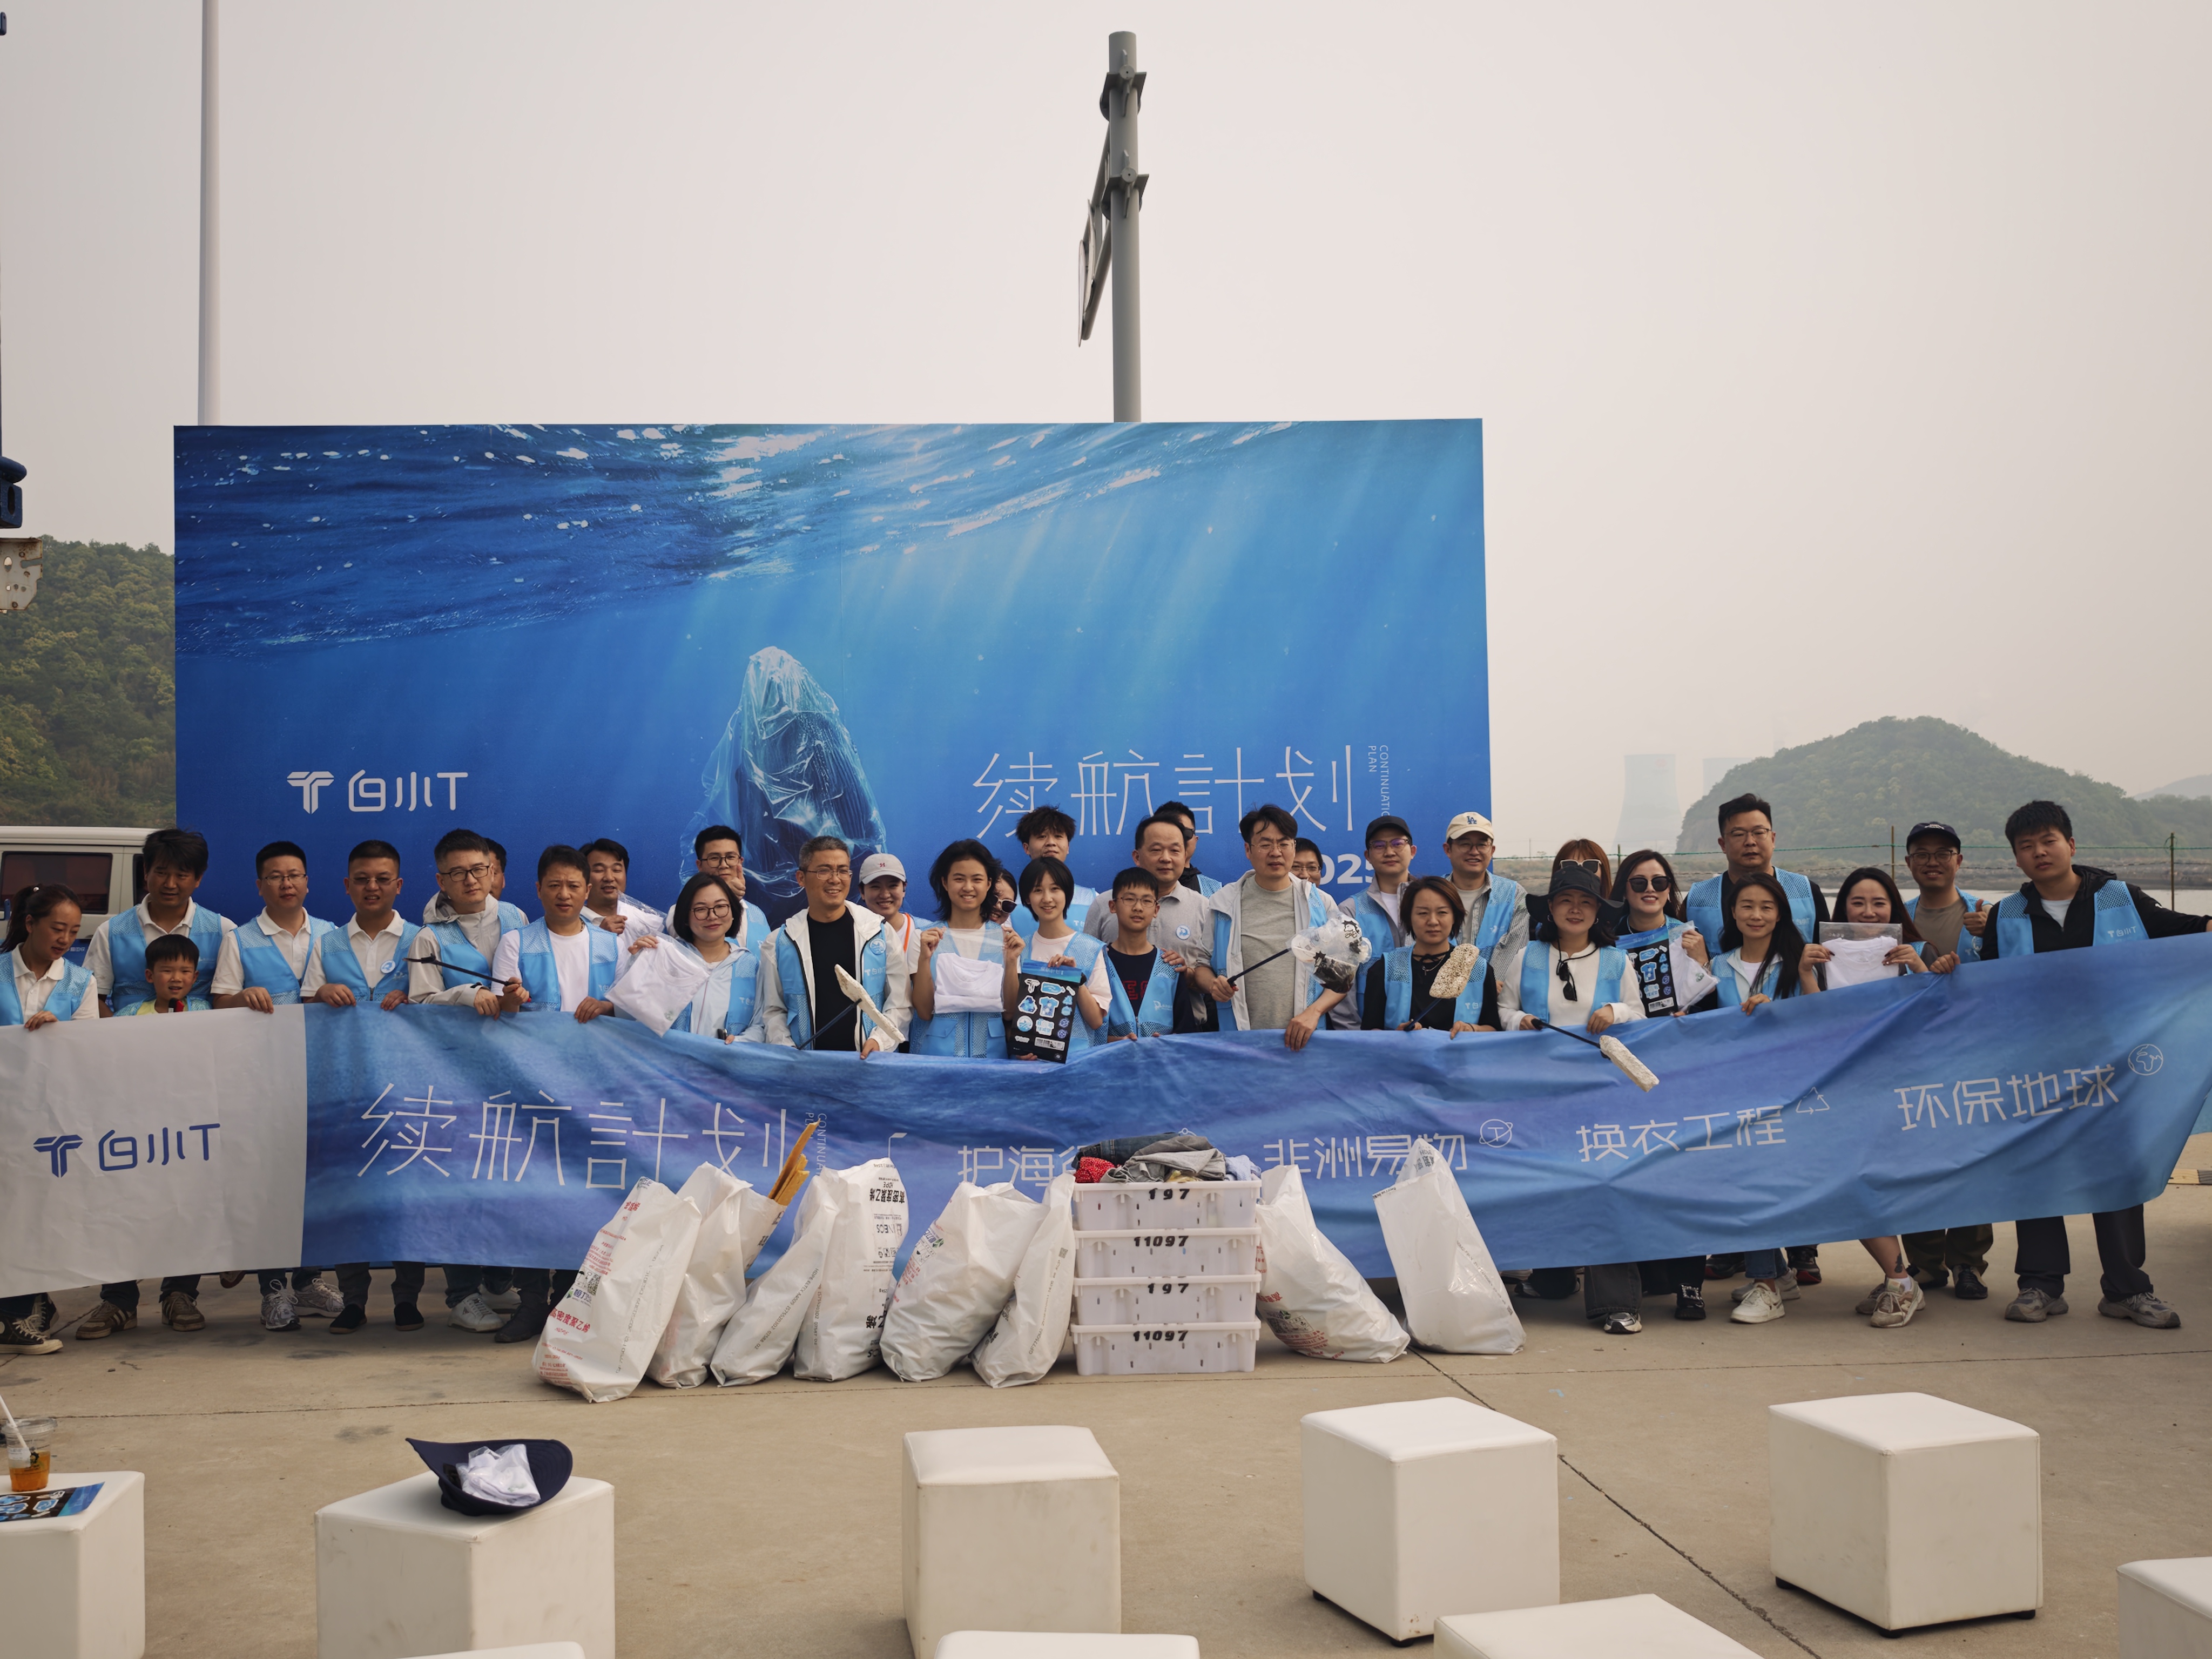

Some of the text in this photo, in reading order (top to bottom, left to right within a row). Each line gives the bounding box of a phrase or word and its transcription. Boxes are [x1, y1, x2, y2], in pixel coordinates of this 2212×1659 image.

[1368, 745, 1377, 772] PLAN
[1380, 745, 1390, 816] CONTINUATIO
[1467, 816, 1477, 824] LA
[1319, 853, 1375, 885] 02
[1894, 1064, 2120, 1130] 环保地球
[817, 1112, 827, 1175] CONTINUA
[1576, 1105, 1786, 1163] 换衣工程
[957, 1145, 1080, 1186] 护海
[869, 1188, 905, 1203] 高密度聚乙烯
[1134, 1236, 1189, 1247] 11097
[549, 1307, 591, 1333] 高密度聚乙烯
[1134, 1330, 1189, 1341] 11097
